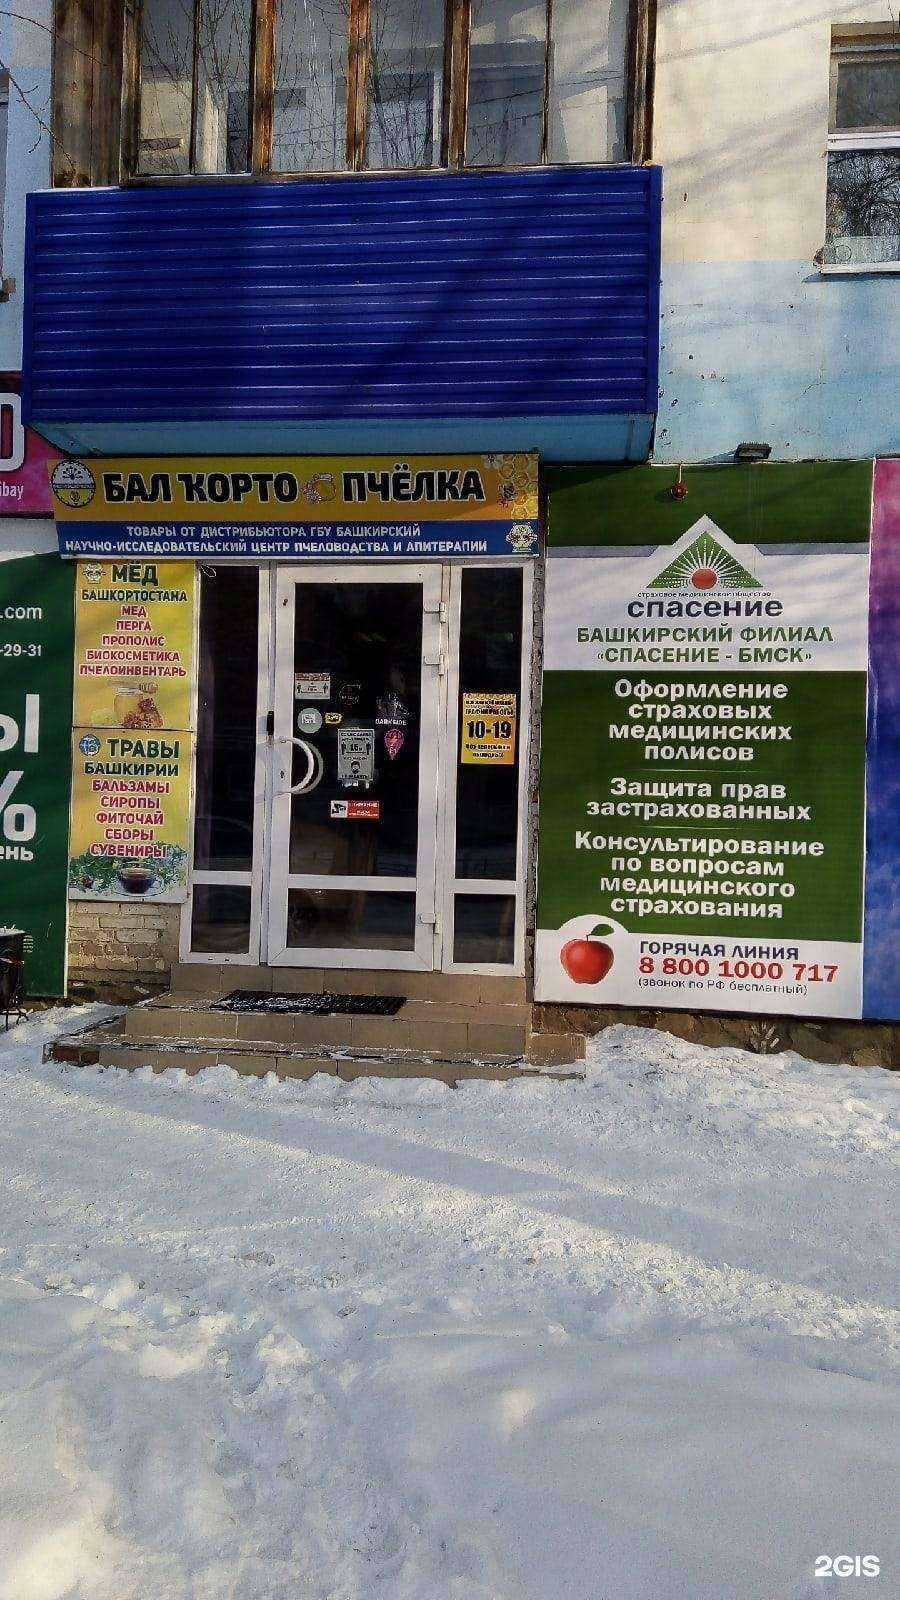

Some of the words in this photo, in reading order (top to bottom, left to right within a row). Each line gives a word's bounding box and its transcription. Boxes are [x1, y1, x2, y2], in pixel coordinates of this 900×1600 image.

[102, 472, 172, 504] БАЛ
[342, 463, 486, 502] ПЧЁЛКА
[127, 526, 177, 537] ТОВАРЫ
[181, 526, 195, 537] ОТ
[200, 526, 306, 538] ДИСТРИБЬЮТОРА
[310, 526, 331, 537] ГБУ
[336, 523, 421, 537] БАШКИРСКИЙ
[65, 538, 245, 552] НАУЧНО-ИССЛЕДОВАТЕЛЬСКИЙ
[251, 541, 290, 553] ЦЕНТР
[294, 541, 389, 553] ПЧЕЛОВОДСТВА
[393, 541, 402, 552] И
[406, 541, 487, 552] АПИТЕРАПИИ
[81, 589, 188, 602] БАШКОРТОСТАНА
[0, 606, 42, 620] .com
[122, 605, 147, 617] МЕД
[627, 600, 783, 618] спасение
[116, 621, 152, 631] ПЕРГА
[577, 622, 732, 643] БАШКИРСКИЙ
[740, 626, 834, 643] ФИЛИАЛ
[102, 636, 165, 646] ПРОПОЛИС
[0, 643, 42, 657] -29-31
[86, 651, 181, 662] БИОКОСМЕТИКА
[597, 647, 719, 662] «СПАСЕНИЕ
[738, 647, 811, 663] БМСК»
[79, 665, 187, 677] ПЧЕЛОИНВЕНТАРЬ
[614, 678, 788, 702] Оформление
[628, 704, 772, 722] страховых
[466, 720, 512, 738] 10-19
[609, 724, 791, 741] медицинских
[107, 739, 180, 759] ТРАВЫ
[645, 745, 754, 761] полисов
[84, 762, 179, 776] БАШКИРИИ
[92, 780, 170, 793] БАЛЬЗАМЫ
[610, 777, 711, 798] Защита
[721, 783, 787, 801] прав
[101, 797, 160, 808] СИРОПЫ
[96, 811, 164, 825] ФИТОЧАЙ
[587, 802, 811, 821] застрахованных
[105, 829, 154, 840] СБОРЫ
[90, 844, 167, 857] СУВЕНИРЫ
[575, 831, 824, 856] Консультирование
[611, 857, 642, 871] по
[650, 858, 784, 877] вопросам
[600, 878, 795, 897] медицинского
[611, 897, 782, 918] страхования
[640, 940, 725, 957] ГОРЯЧАЯ
[731, 945, 799, 960] ЛИНИЯ
[638, 957, 654, 974] 8
[662, 957, 709, 976] 800
[718, 959, 783, 980] 1000
[792, 963, 838, 982] 717
[638, 978, 686, 989] (звонок
[689, 980, 704, 990] по
[707, 980, 725, 990] РФ
[729, 981, 807, 996] бесплатный)
